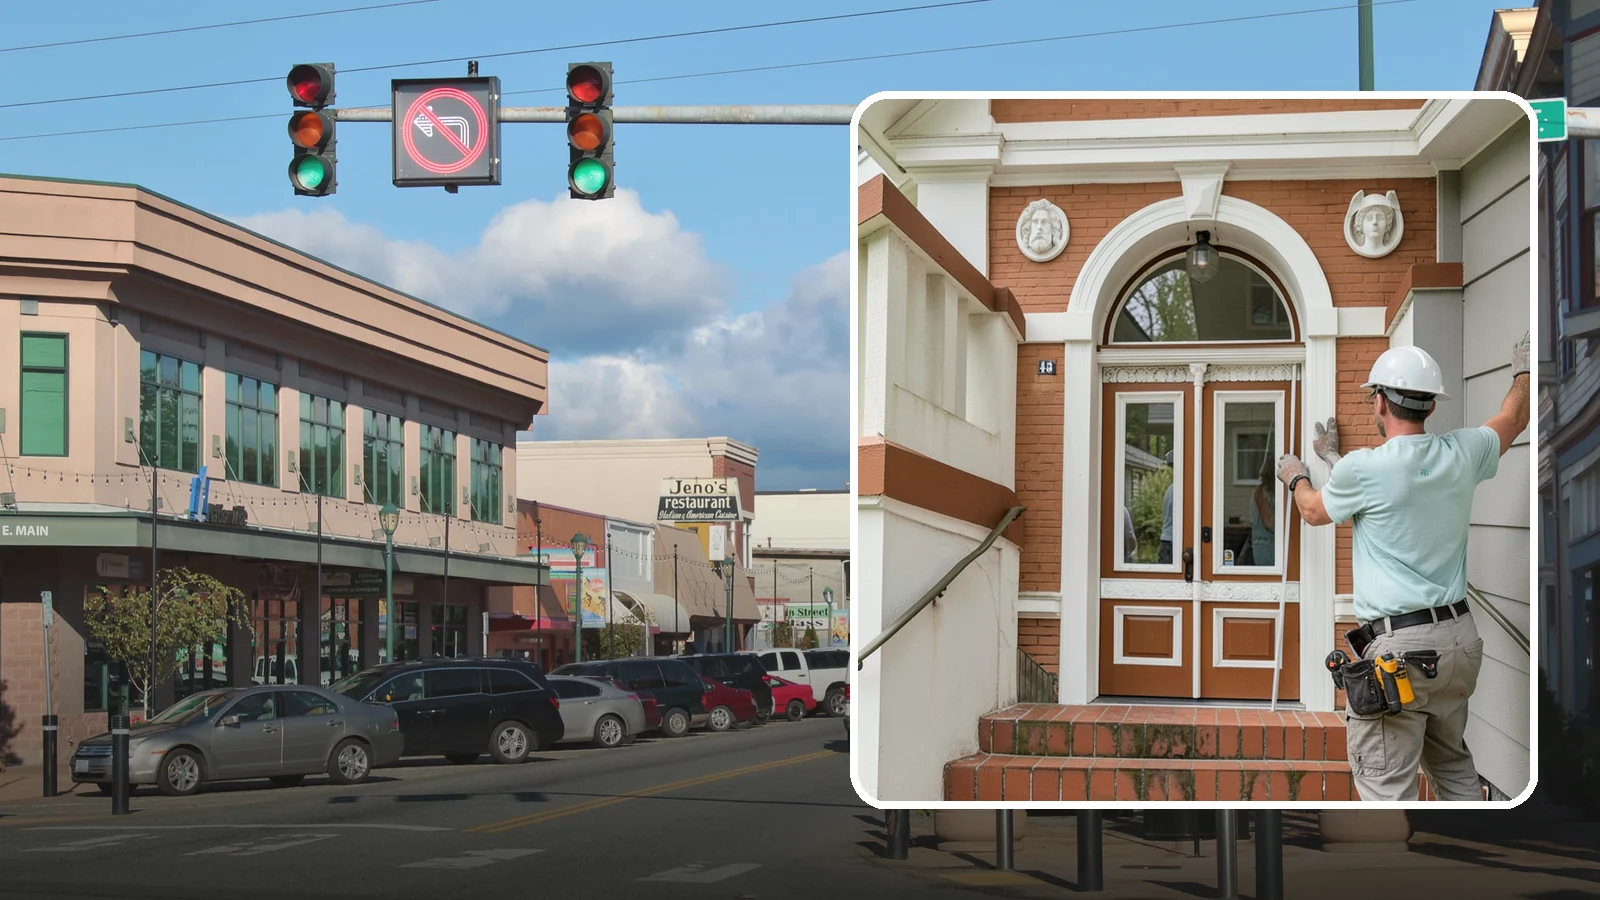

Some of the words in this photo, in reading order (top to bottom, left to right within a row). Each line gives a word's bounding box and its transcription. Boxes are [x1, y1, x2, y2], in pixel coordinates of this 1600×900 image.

[669, 480, 727, 494] Jeno's
[665, 496, 731, 509] restaurant
[659, 510, 681, 519] Italian
[686, 509, 714, 519] American
[715, 509, 737, 519] Cuisine
[2, 525, 13, 536] E.
[15, 525, 49, 536] MAIN
[797, 607, 828, 617] Street
